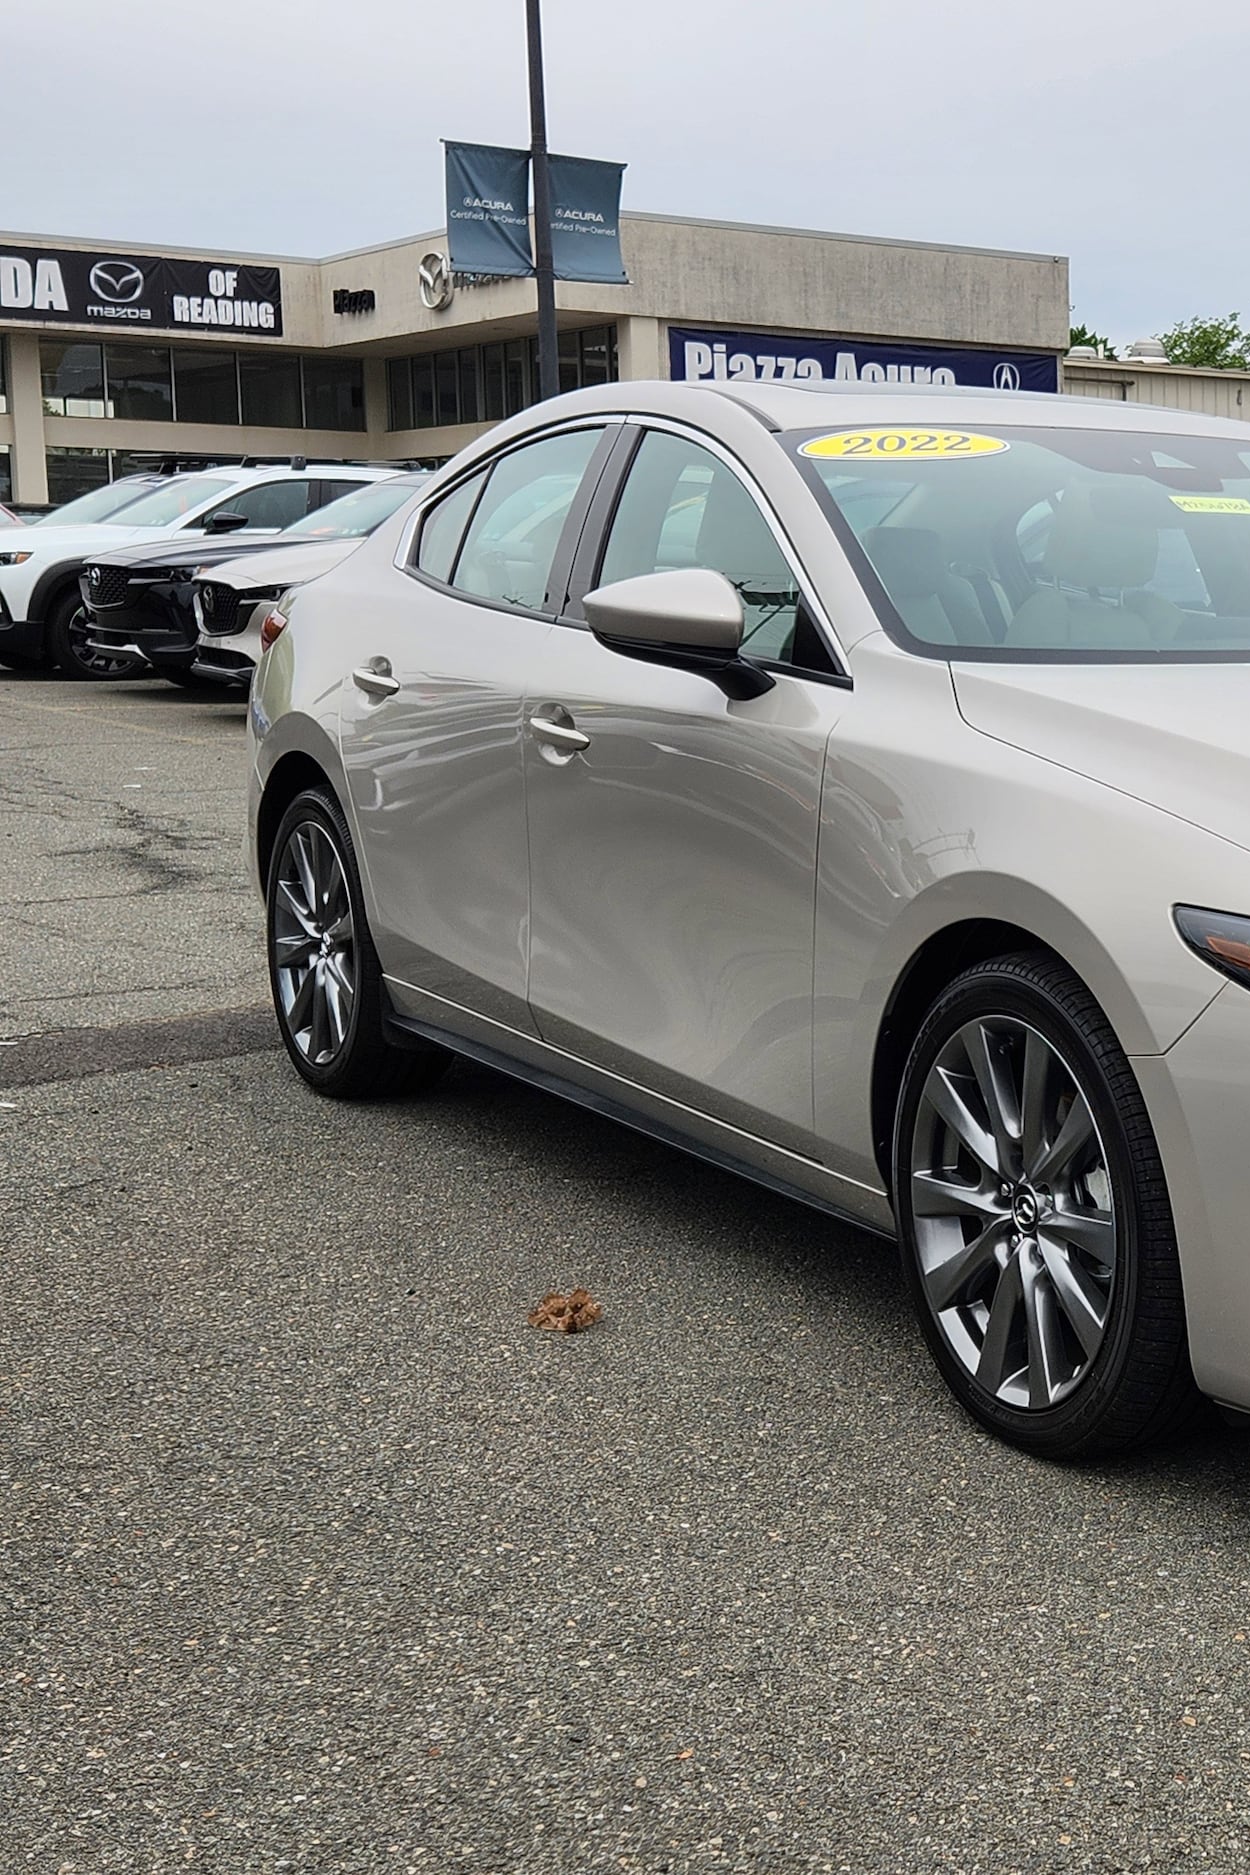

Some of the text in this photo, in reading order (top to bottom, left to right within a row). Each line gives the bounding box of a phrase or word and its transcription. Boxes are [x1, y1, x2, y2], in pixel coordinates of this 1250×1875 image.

[472, 198, 514, 212] ACURA
[450, 209, 484, 221] Certified
[563, 209, 604, 223] ACURA
[550, 221, 616, 237] rtified Pre-Owned
[208, 269, 238, 297] OF
[173, 295, 275, 329] READING
[684, 341, 823, 381] Piazza
[842, 434, 972, 456] 2022
